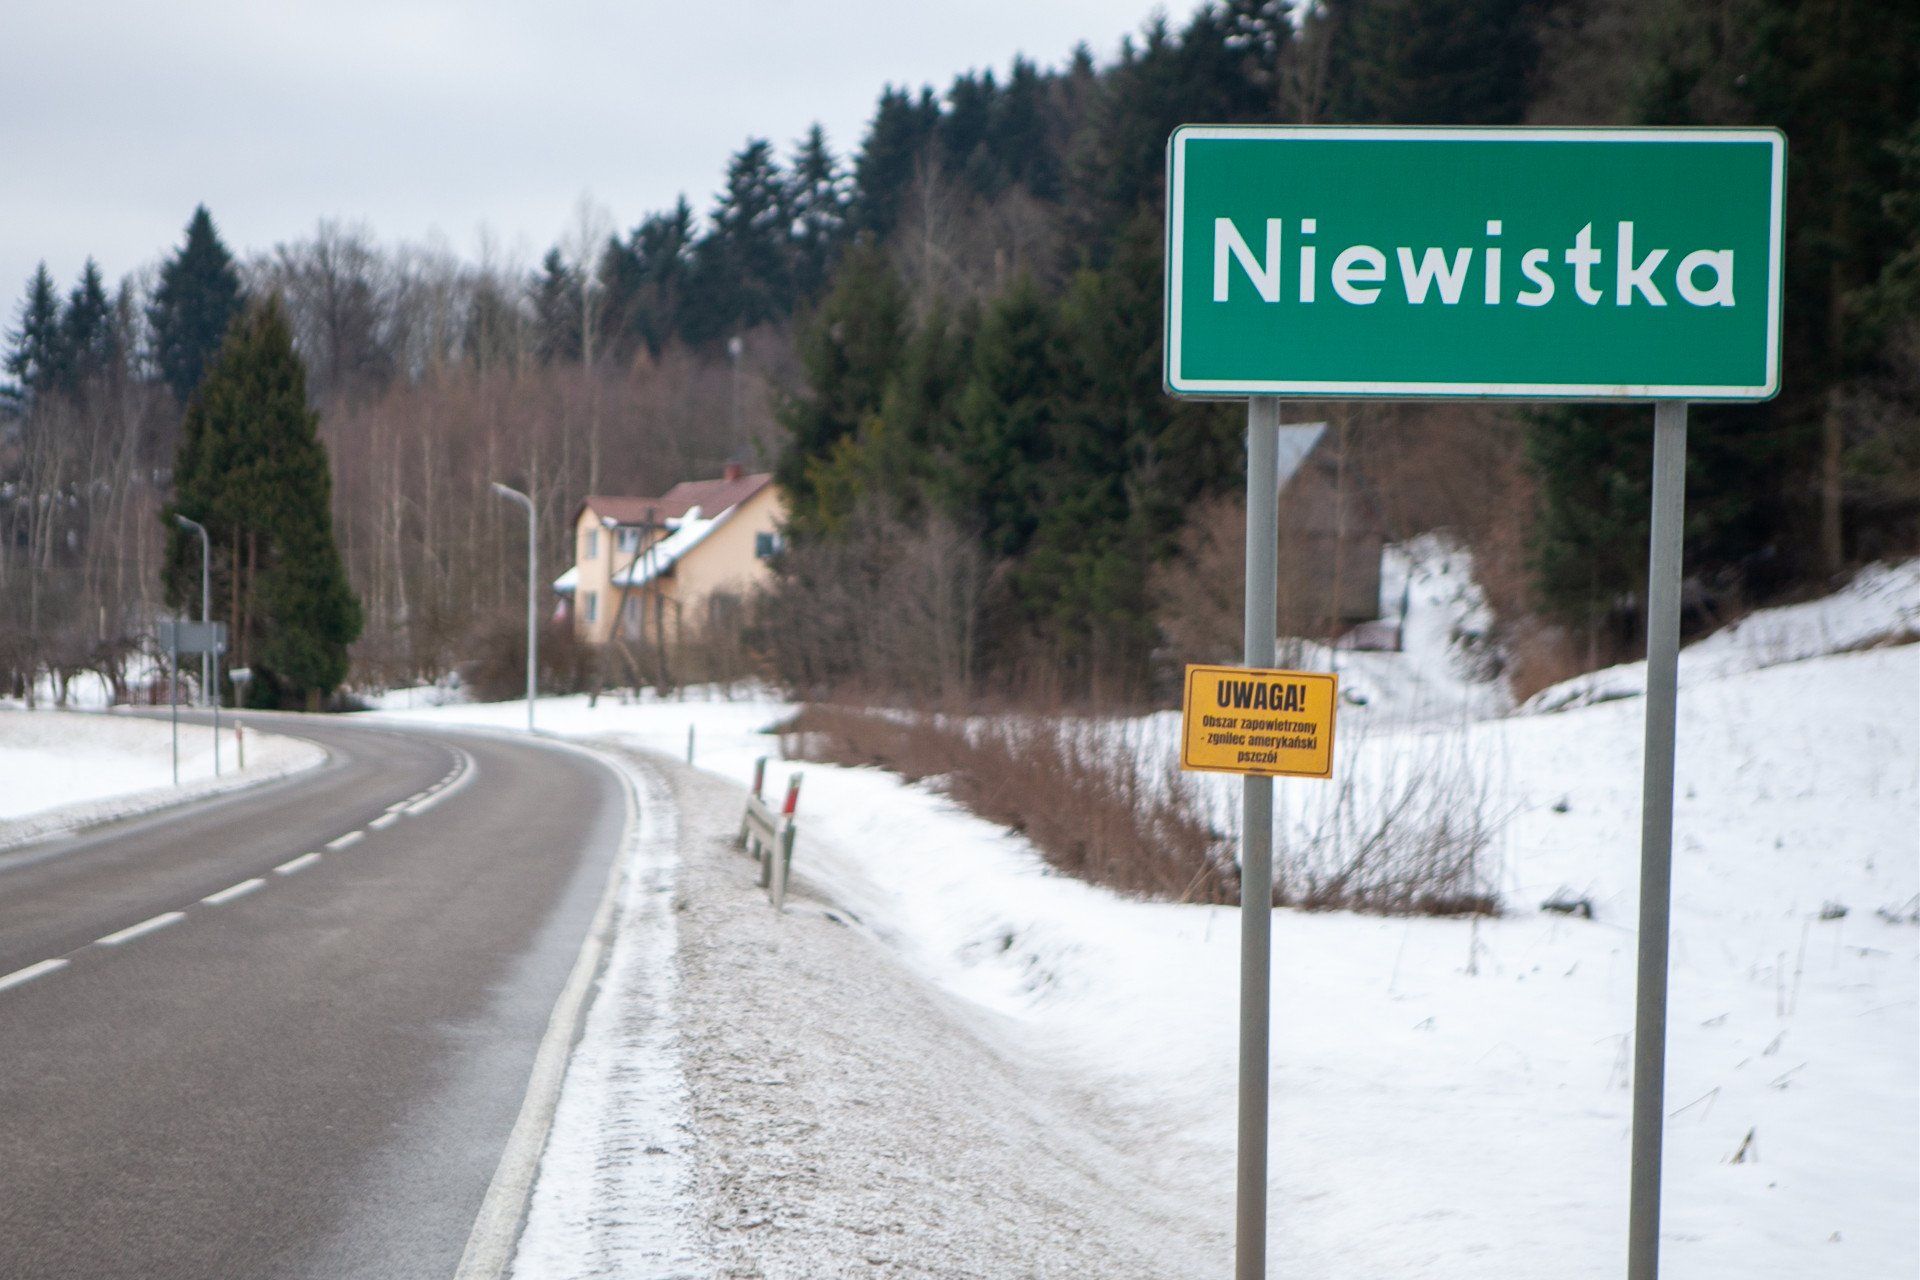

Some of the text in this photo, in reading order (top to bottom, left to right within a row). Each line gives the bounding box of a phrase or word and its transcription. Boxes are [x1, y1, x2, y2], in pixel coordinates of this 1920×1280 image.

[1213, 217, 1736, 307] Niewistka
[1217, 680, 1306, 712] UWAGA!
[1202, 714, 1317, 735] Obszar zapowietrzony
[1207, 732, 1245, 745] zgnilec
[1248, 735, 1317, 750] amerykański
[1237, 751, 1278, 764] pszczół
